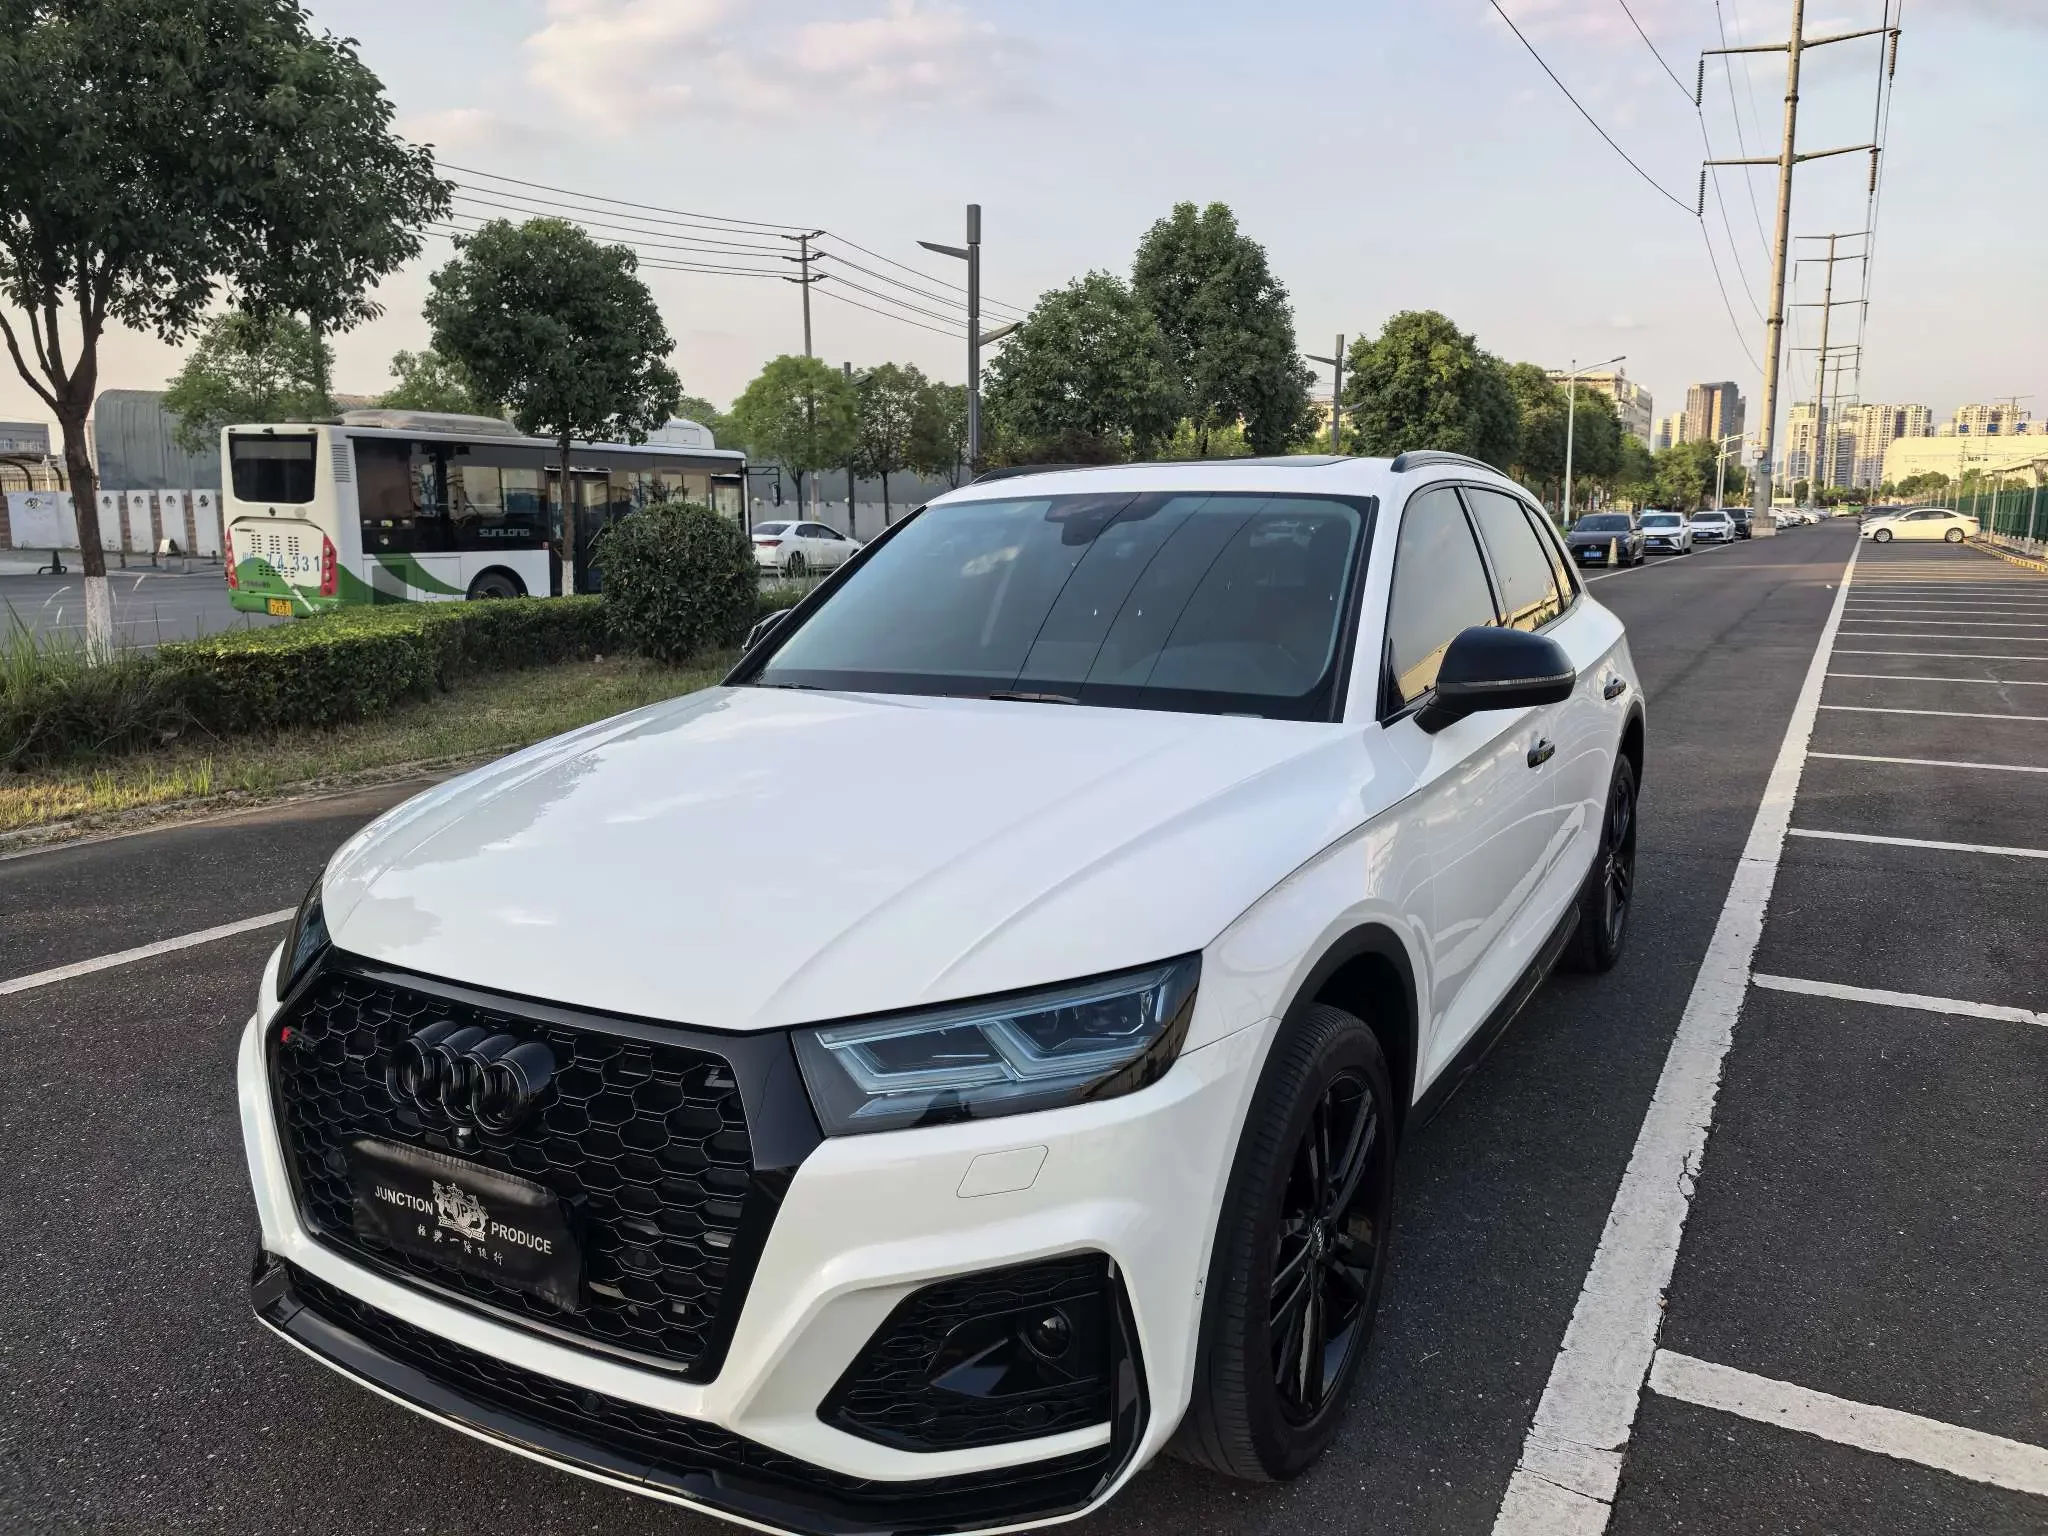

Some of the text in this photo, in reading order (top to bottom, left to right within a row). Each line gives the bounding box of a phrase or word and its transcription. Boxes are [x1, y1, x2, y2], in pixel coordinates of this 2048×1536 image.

[479, 528, 530, 537] SUNLONG
[375, 1185, 552, 1255] JUNCTION PRODUCE
